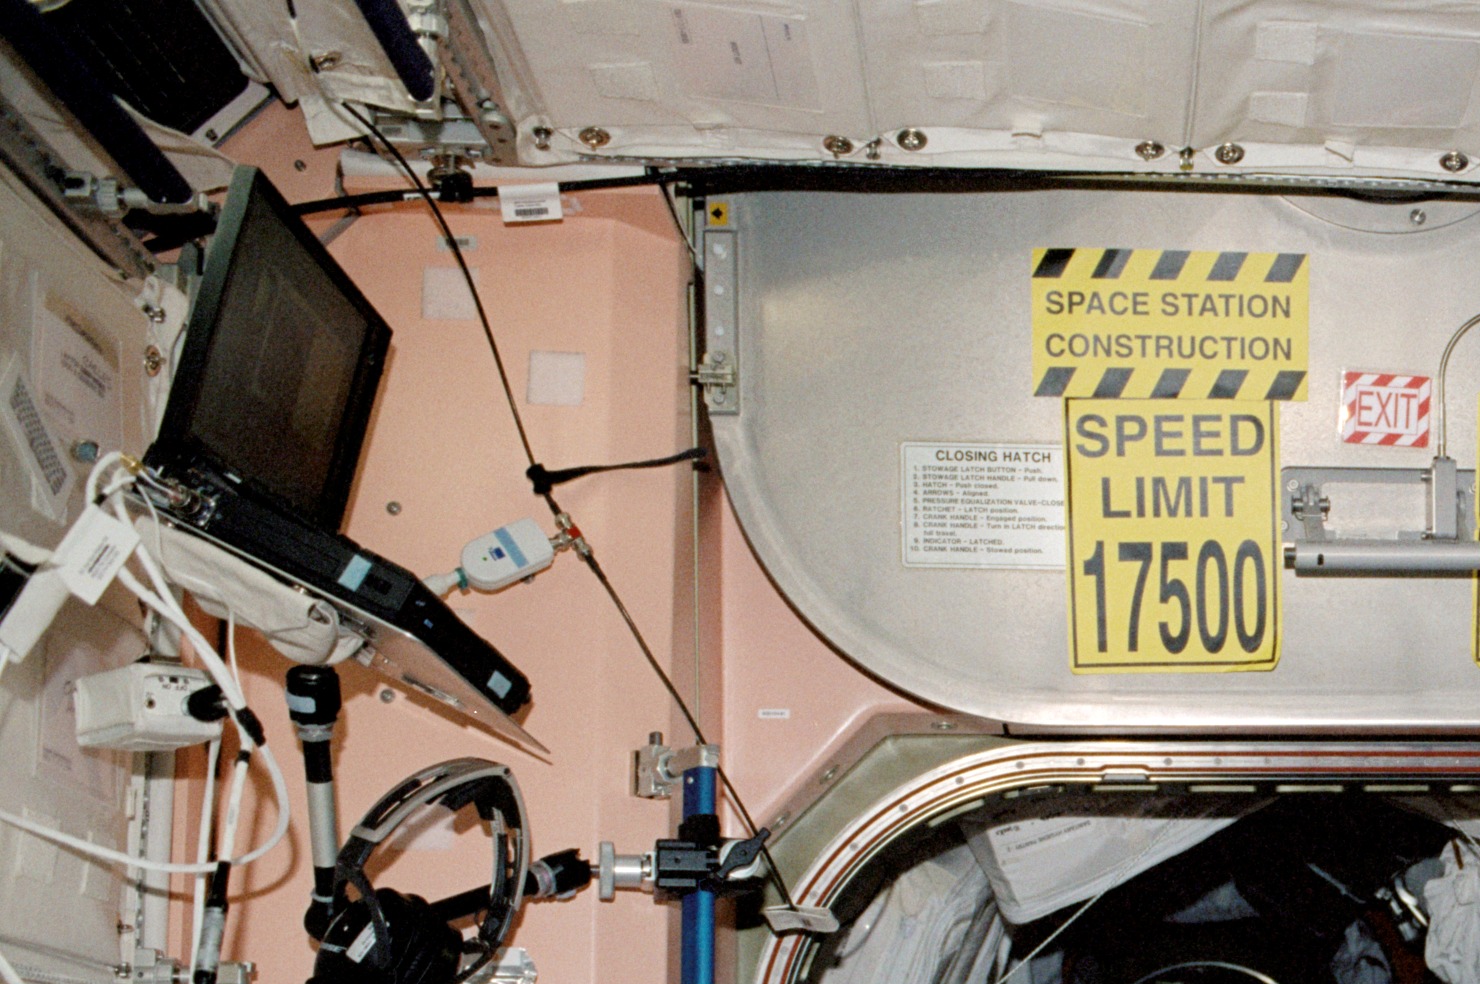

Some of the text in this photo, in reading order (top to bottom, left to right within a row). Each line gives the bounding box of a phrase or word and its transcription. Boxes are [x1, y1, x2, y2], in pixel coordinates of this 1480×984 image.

[1045, 291, 1291, 318] SPACE STATION
[1045, 333, 1292, 360] CONSTRUCTION
[1358, 391, 1417, 429] EXIT
[1076, 413, 1265, 458] SPEED
[936, 450, 1051, 463] CLOSING HATCH
[1102, 476, 1245, 518] LIMIT
[1083, 539, 1266, 654] 17500
